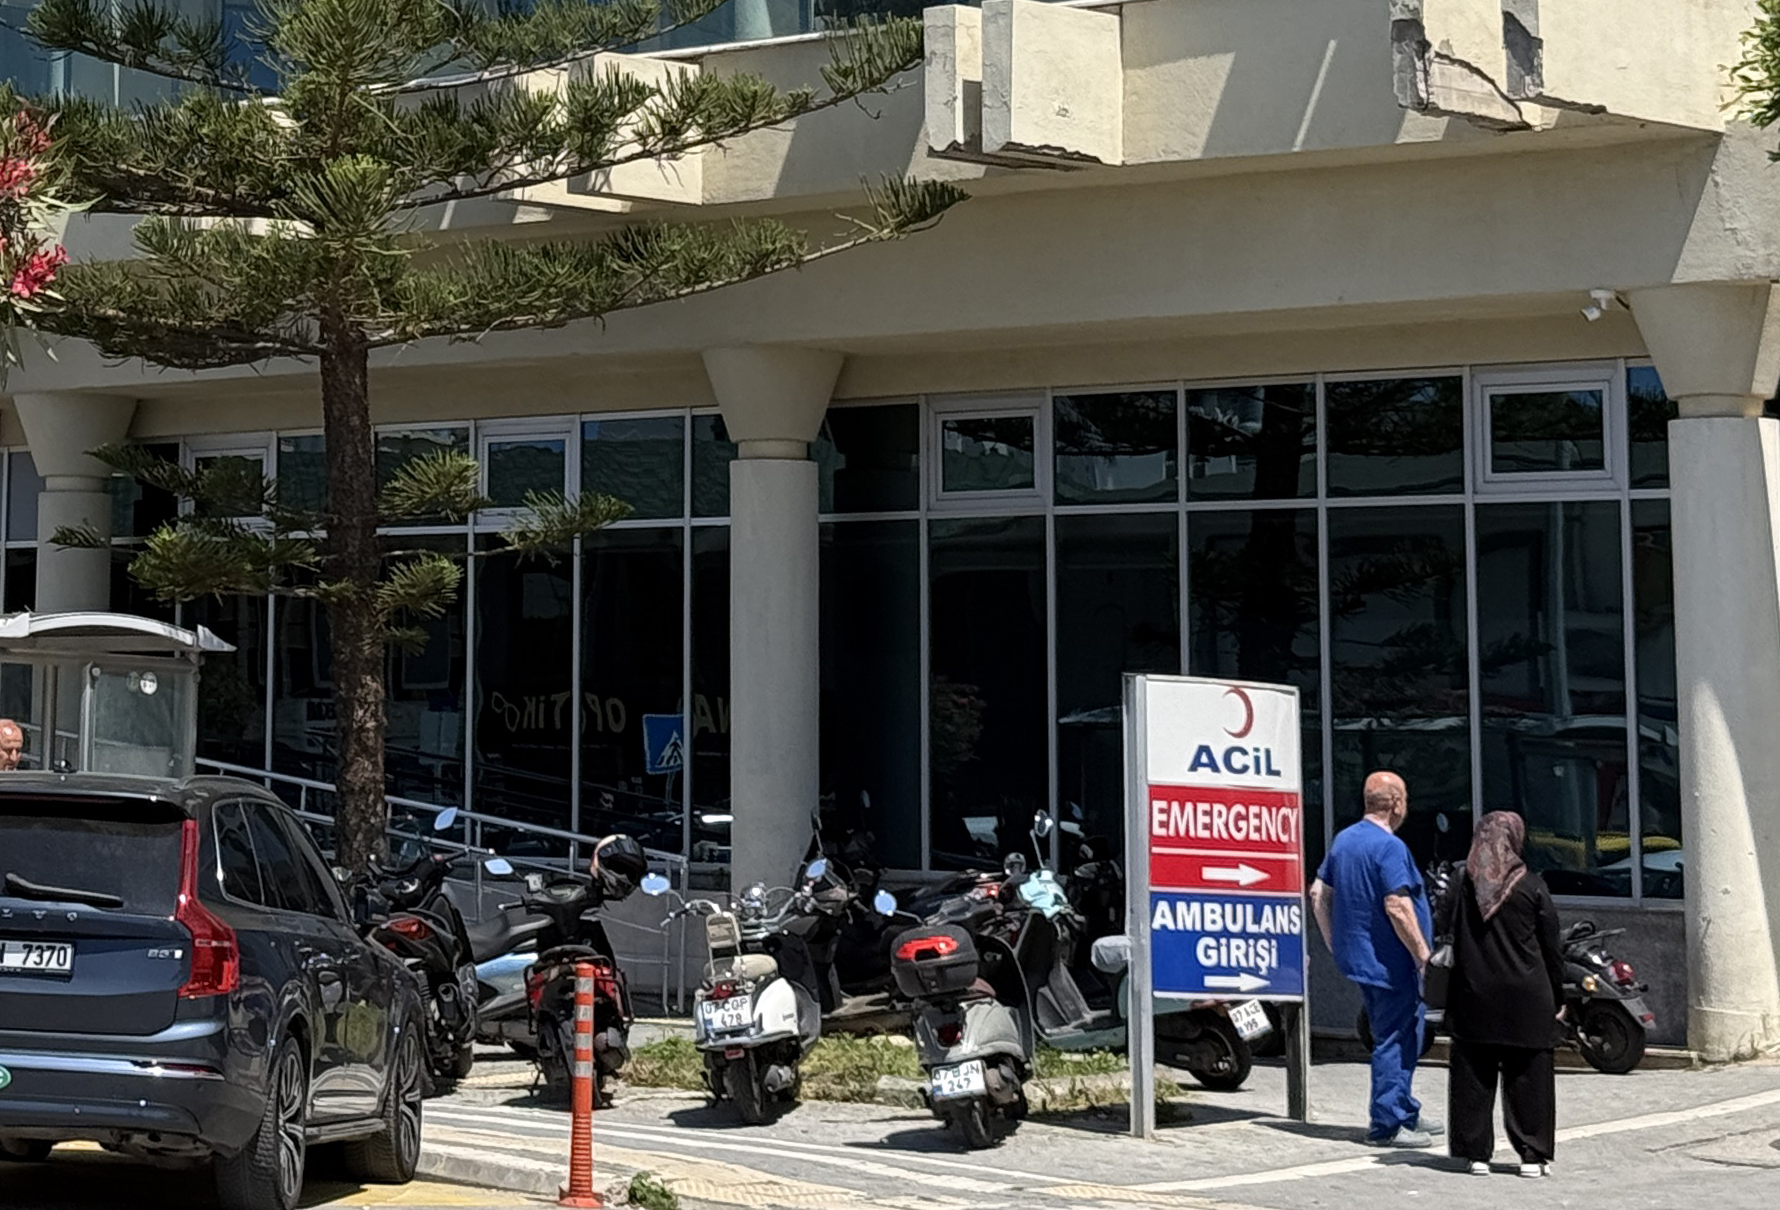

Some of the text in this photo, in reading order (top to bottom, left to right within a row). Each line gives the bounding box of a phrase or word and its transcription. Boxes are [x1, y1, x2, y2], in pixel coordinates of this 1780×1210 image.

[1151, 800, 1299, 843] EMERGENCY
[1151, 900, 1301, 935] AMBULANS
[22, 944, 68, 967] 7370
